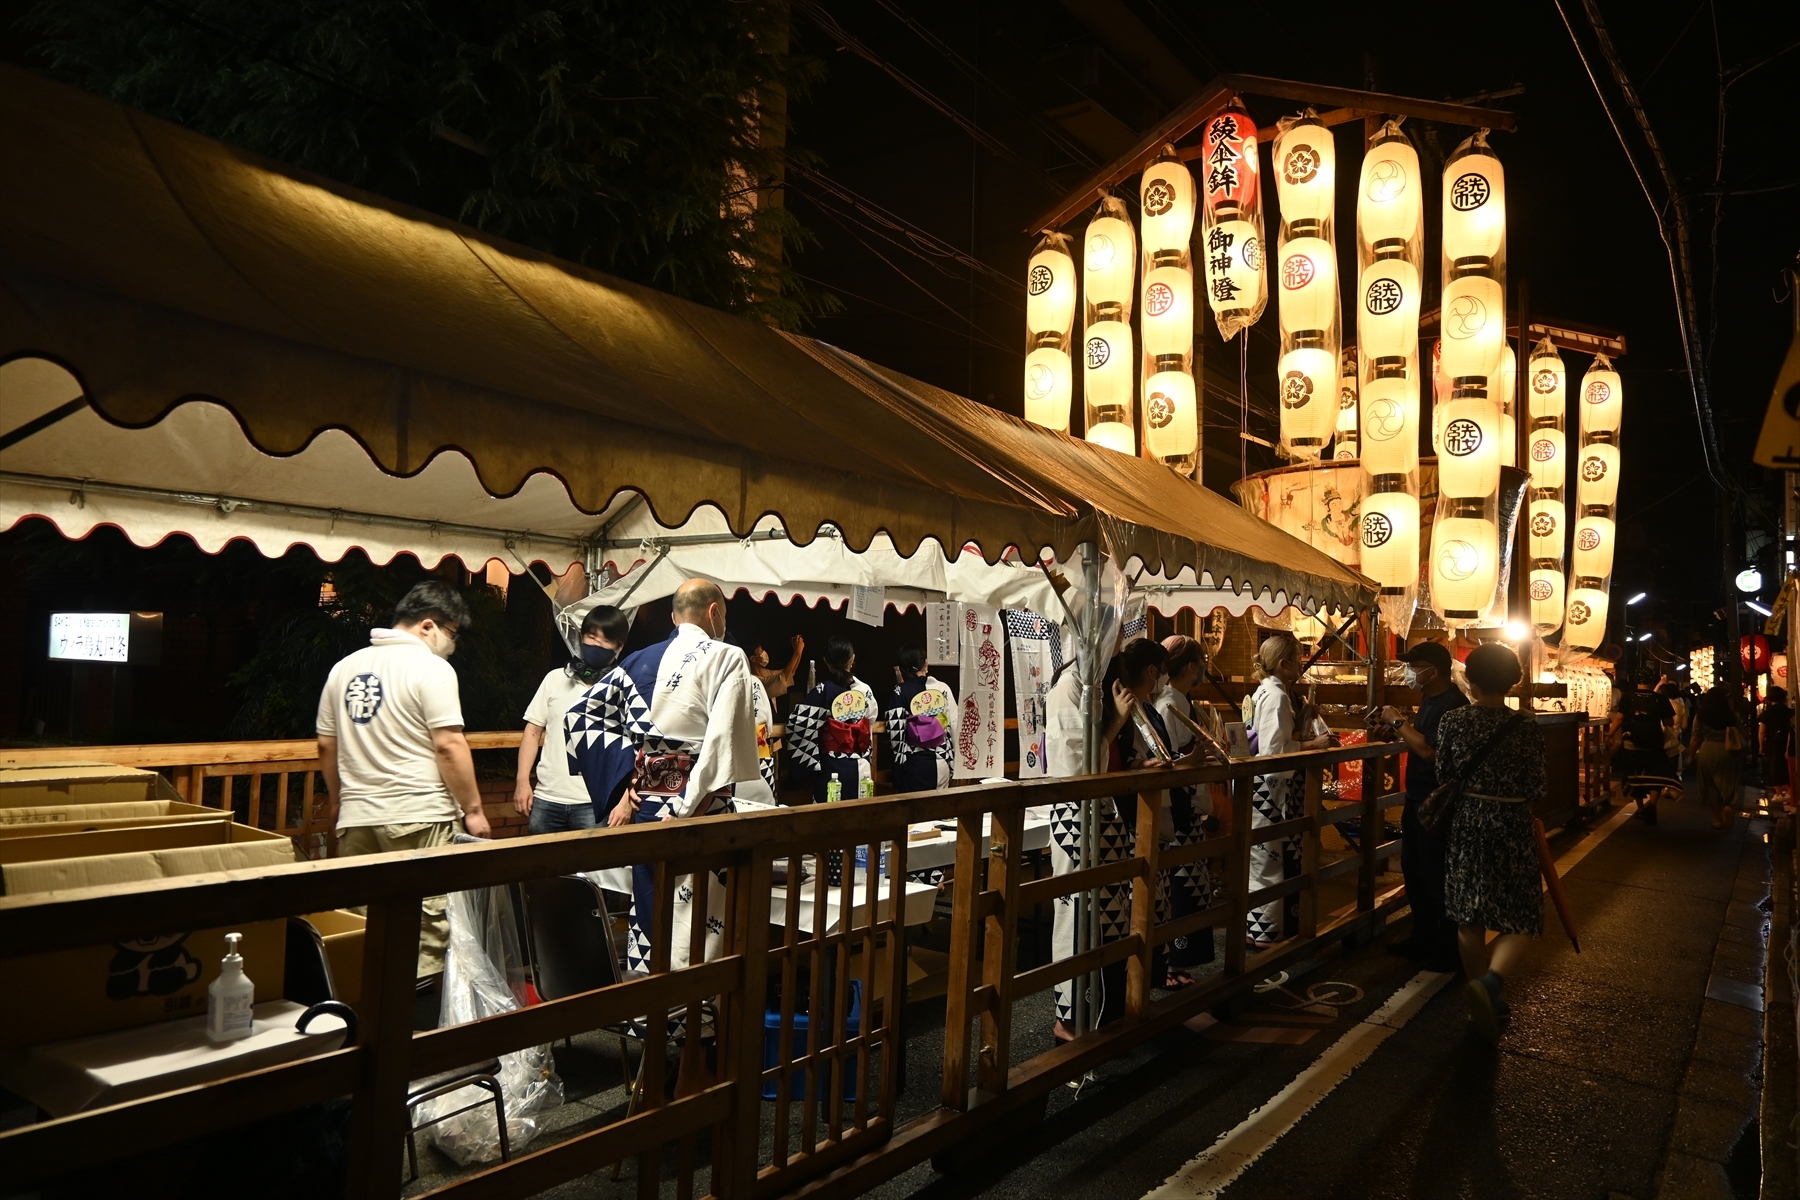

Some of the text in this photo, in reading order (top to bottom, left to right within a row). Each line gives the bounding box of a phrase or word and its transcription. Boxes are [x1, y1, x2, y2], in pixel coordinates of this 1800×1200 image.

[1208, 116, 1241, 197] 綾傘鉾
[1208, 227, 1242, 302] 御神燈
